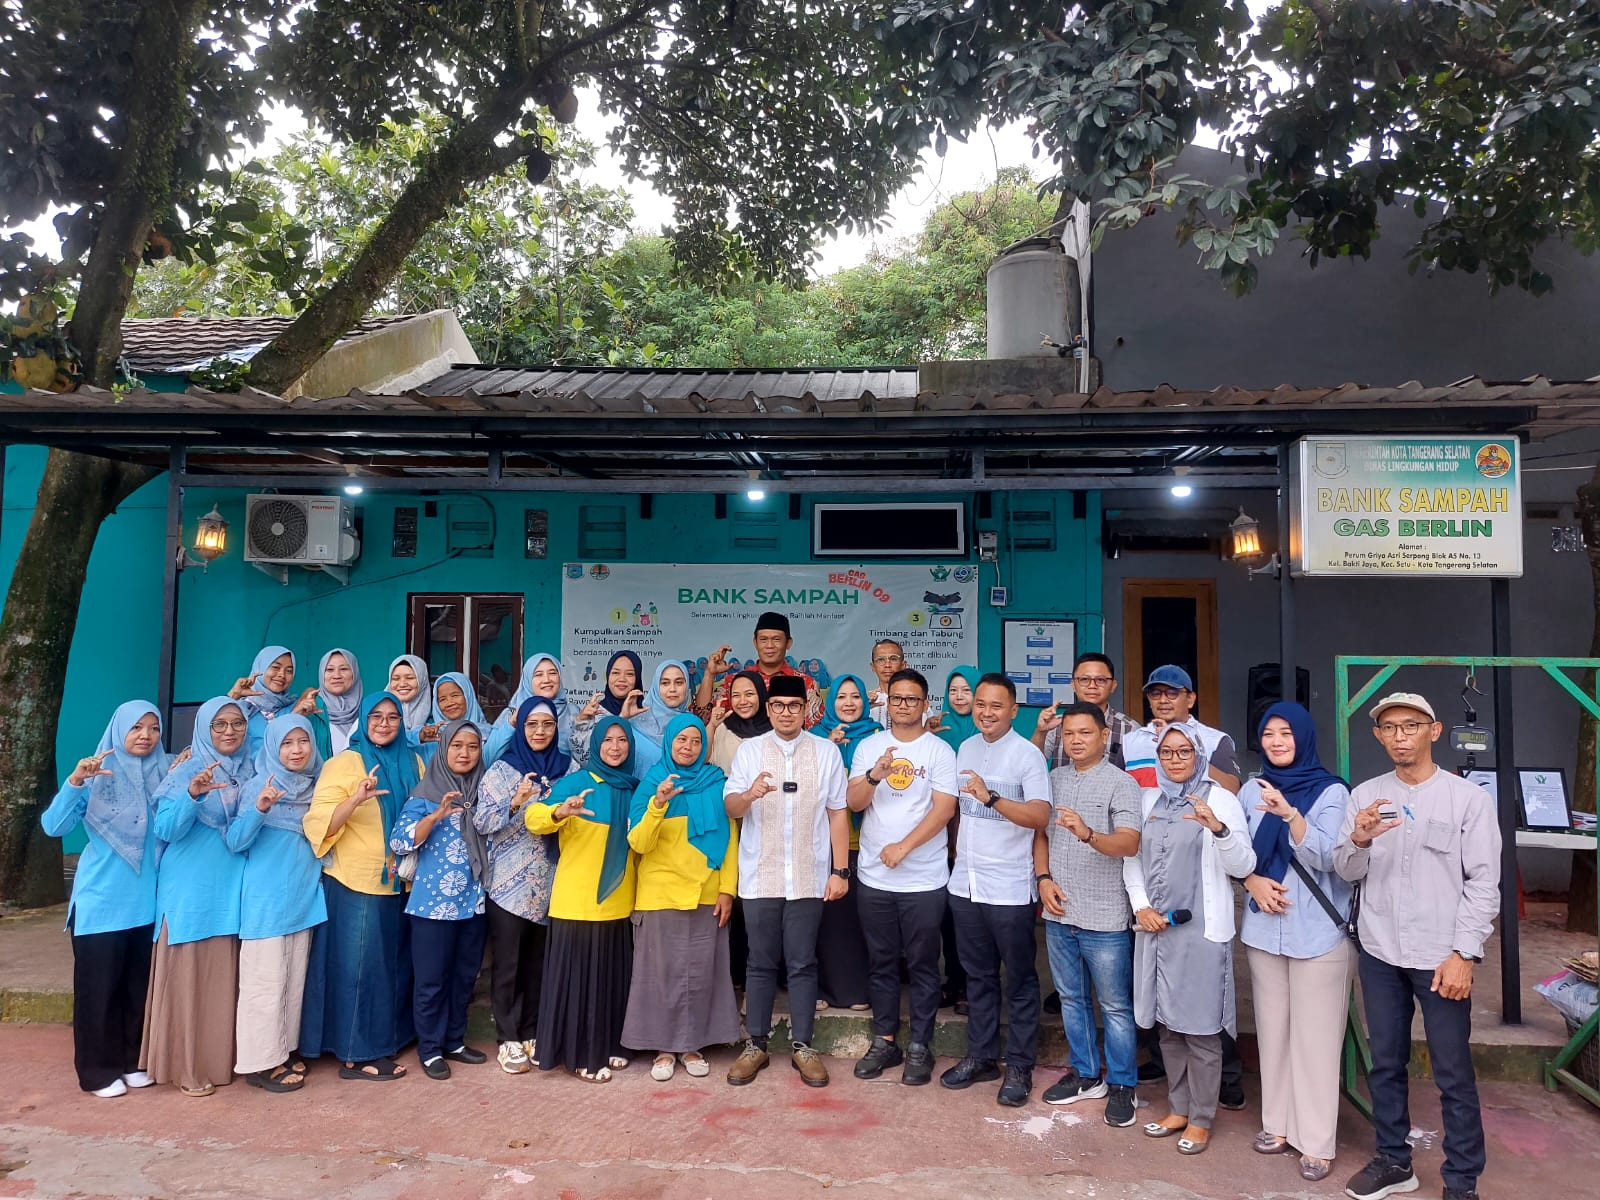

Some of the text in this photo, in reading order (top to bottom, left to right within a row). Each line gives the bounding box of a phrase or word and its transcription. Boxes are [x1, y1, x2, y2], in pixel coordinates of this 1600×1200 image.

[1408, 445, 1444, 459] TANGERANG
[1445, 445, 1471, 459] SELATAN
[1388, 461, 1434, 472] LINGKUNGAN
[1436, 462, 1460, 472] HIDUP
[1317, 487, 1509, 513] BANK SAMPAH
[1333, 518, 1493, 537] GAS BERLIN
[829, 573, 873, 592] BERLIN
[677, 588, 860, 605] BANK SAMPAH
[912, 614, 920, 622] 3
[574, 628, 663, 637] Kumpulkan Sampah
[868, 629, 964, 639] Timbang dan Tabung
[581, 637, 655, 646] Pisahkan sampah
[912, 639, 958, 649] ditimbang
[927, 651, 958, 659] dibuku
